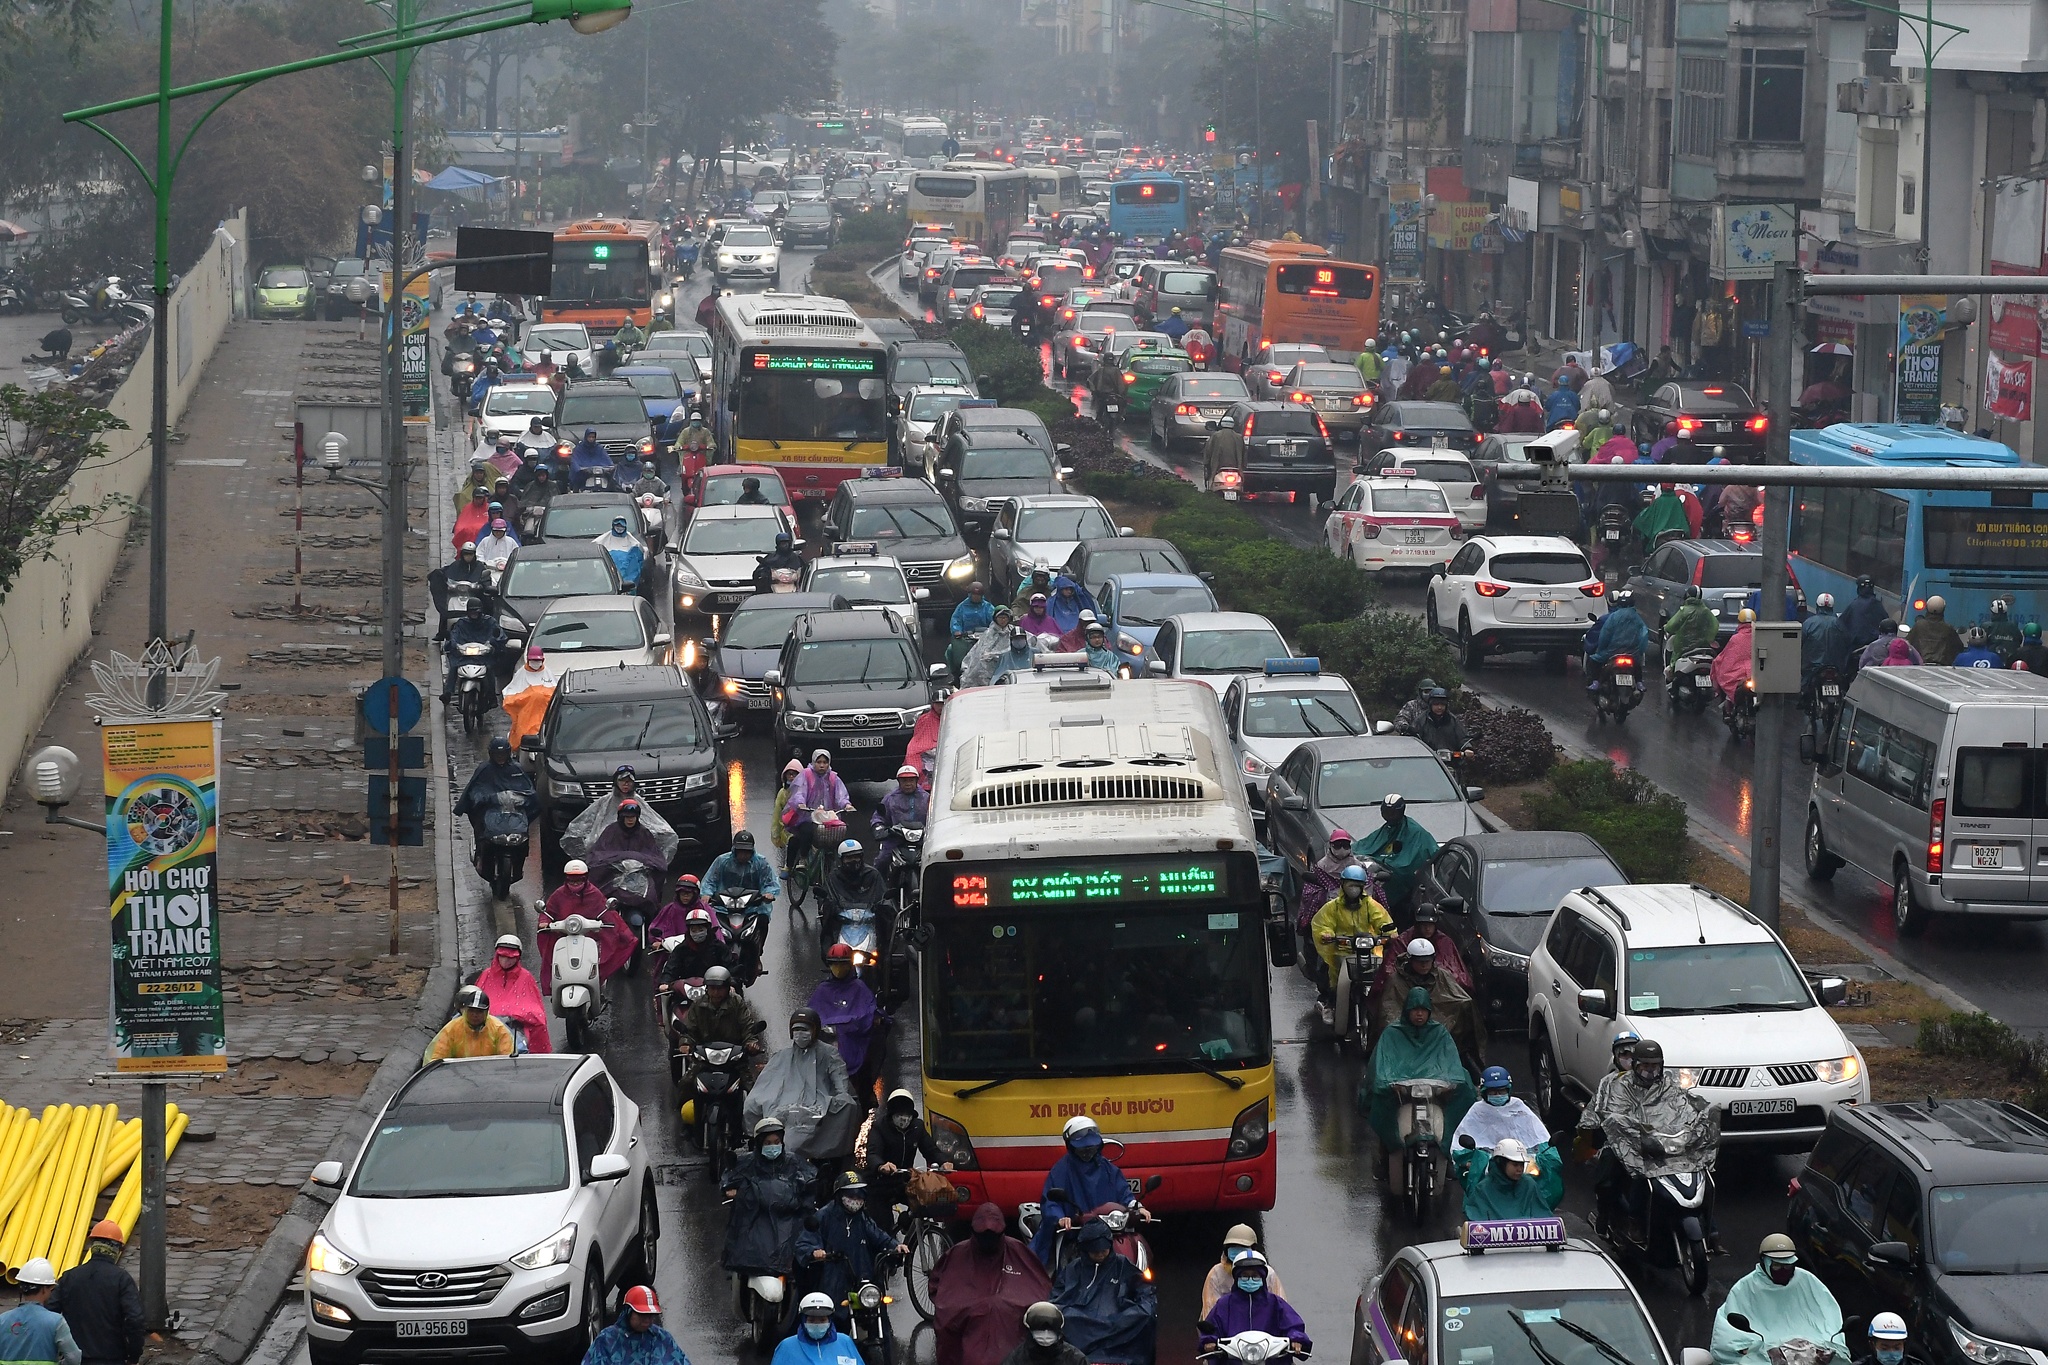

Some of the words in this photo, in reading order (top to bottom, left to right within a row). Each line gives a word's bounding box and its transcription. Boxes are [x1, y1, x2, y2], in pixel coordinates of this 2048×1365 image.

[1318, 271, 1332, 283] 90
[402, 343, 426, 362] HỜI
[1903, 370, 1938, 383] TRANG
[1988, 523, 2003, 533] BUS
[1538, 601, 1551, 610] 30E
[841, 738, 883, 747] 30E-601.60
[1975, 847, 2000, 857] 80-297
[1977, 857, 1997, 866] NG-24
[124, 865, 160, 895] HỘI
[166, 865, 211, 892] CHỢ
[125, 888, 211, 931] THỜI
[127, 927, 211, 957] TRANG
[128, 956, 156, 972] VIỆT
[157, 958, 184, 968] NAM
[184, 956, 211, 968] 2017
[162, 969, 194, 977] FASHION
[146, 983, 196, 993] 22-26/12
[1057, 1102, 1087, 1118] BUS
[1090, 1097, 1123, 1116] CẦU
[1127, 1097, 1174, 1115] BƯƠU
[1733, 1100, 1794, 1115] 30A-207.56
[1490, 1223, 1516, 1242] MỸ
[1516, 1222, 1559, 1241] ĐÌNH
[398, 1320, 466, 1336] 30A-956.69
[1448, 1321, 1460, 1330] 82
